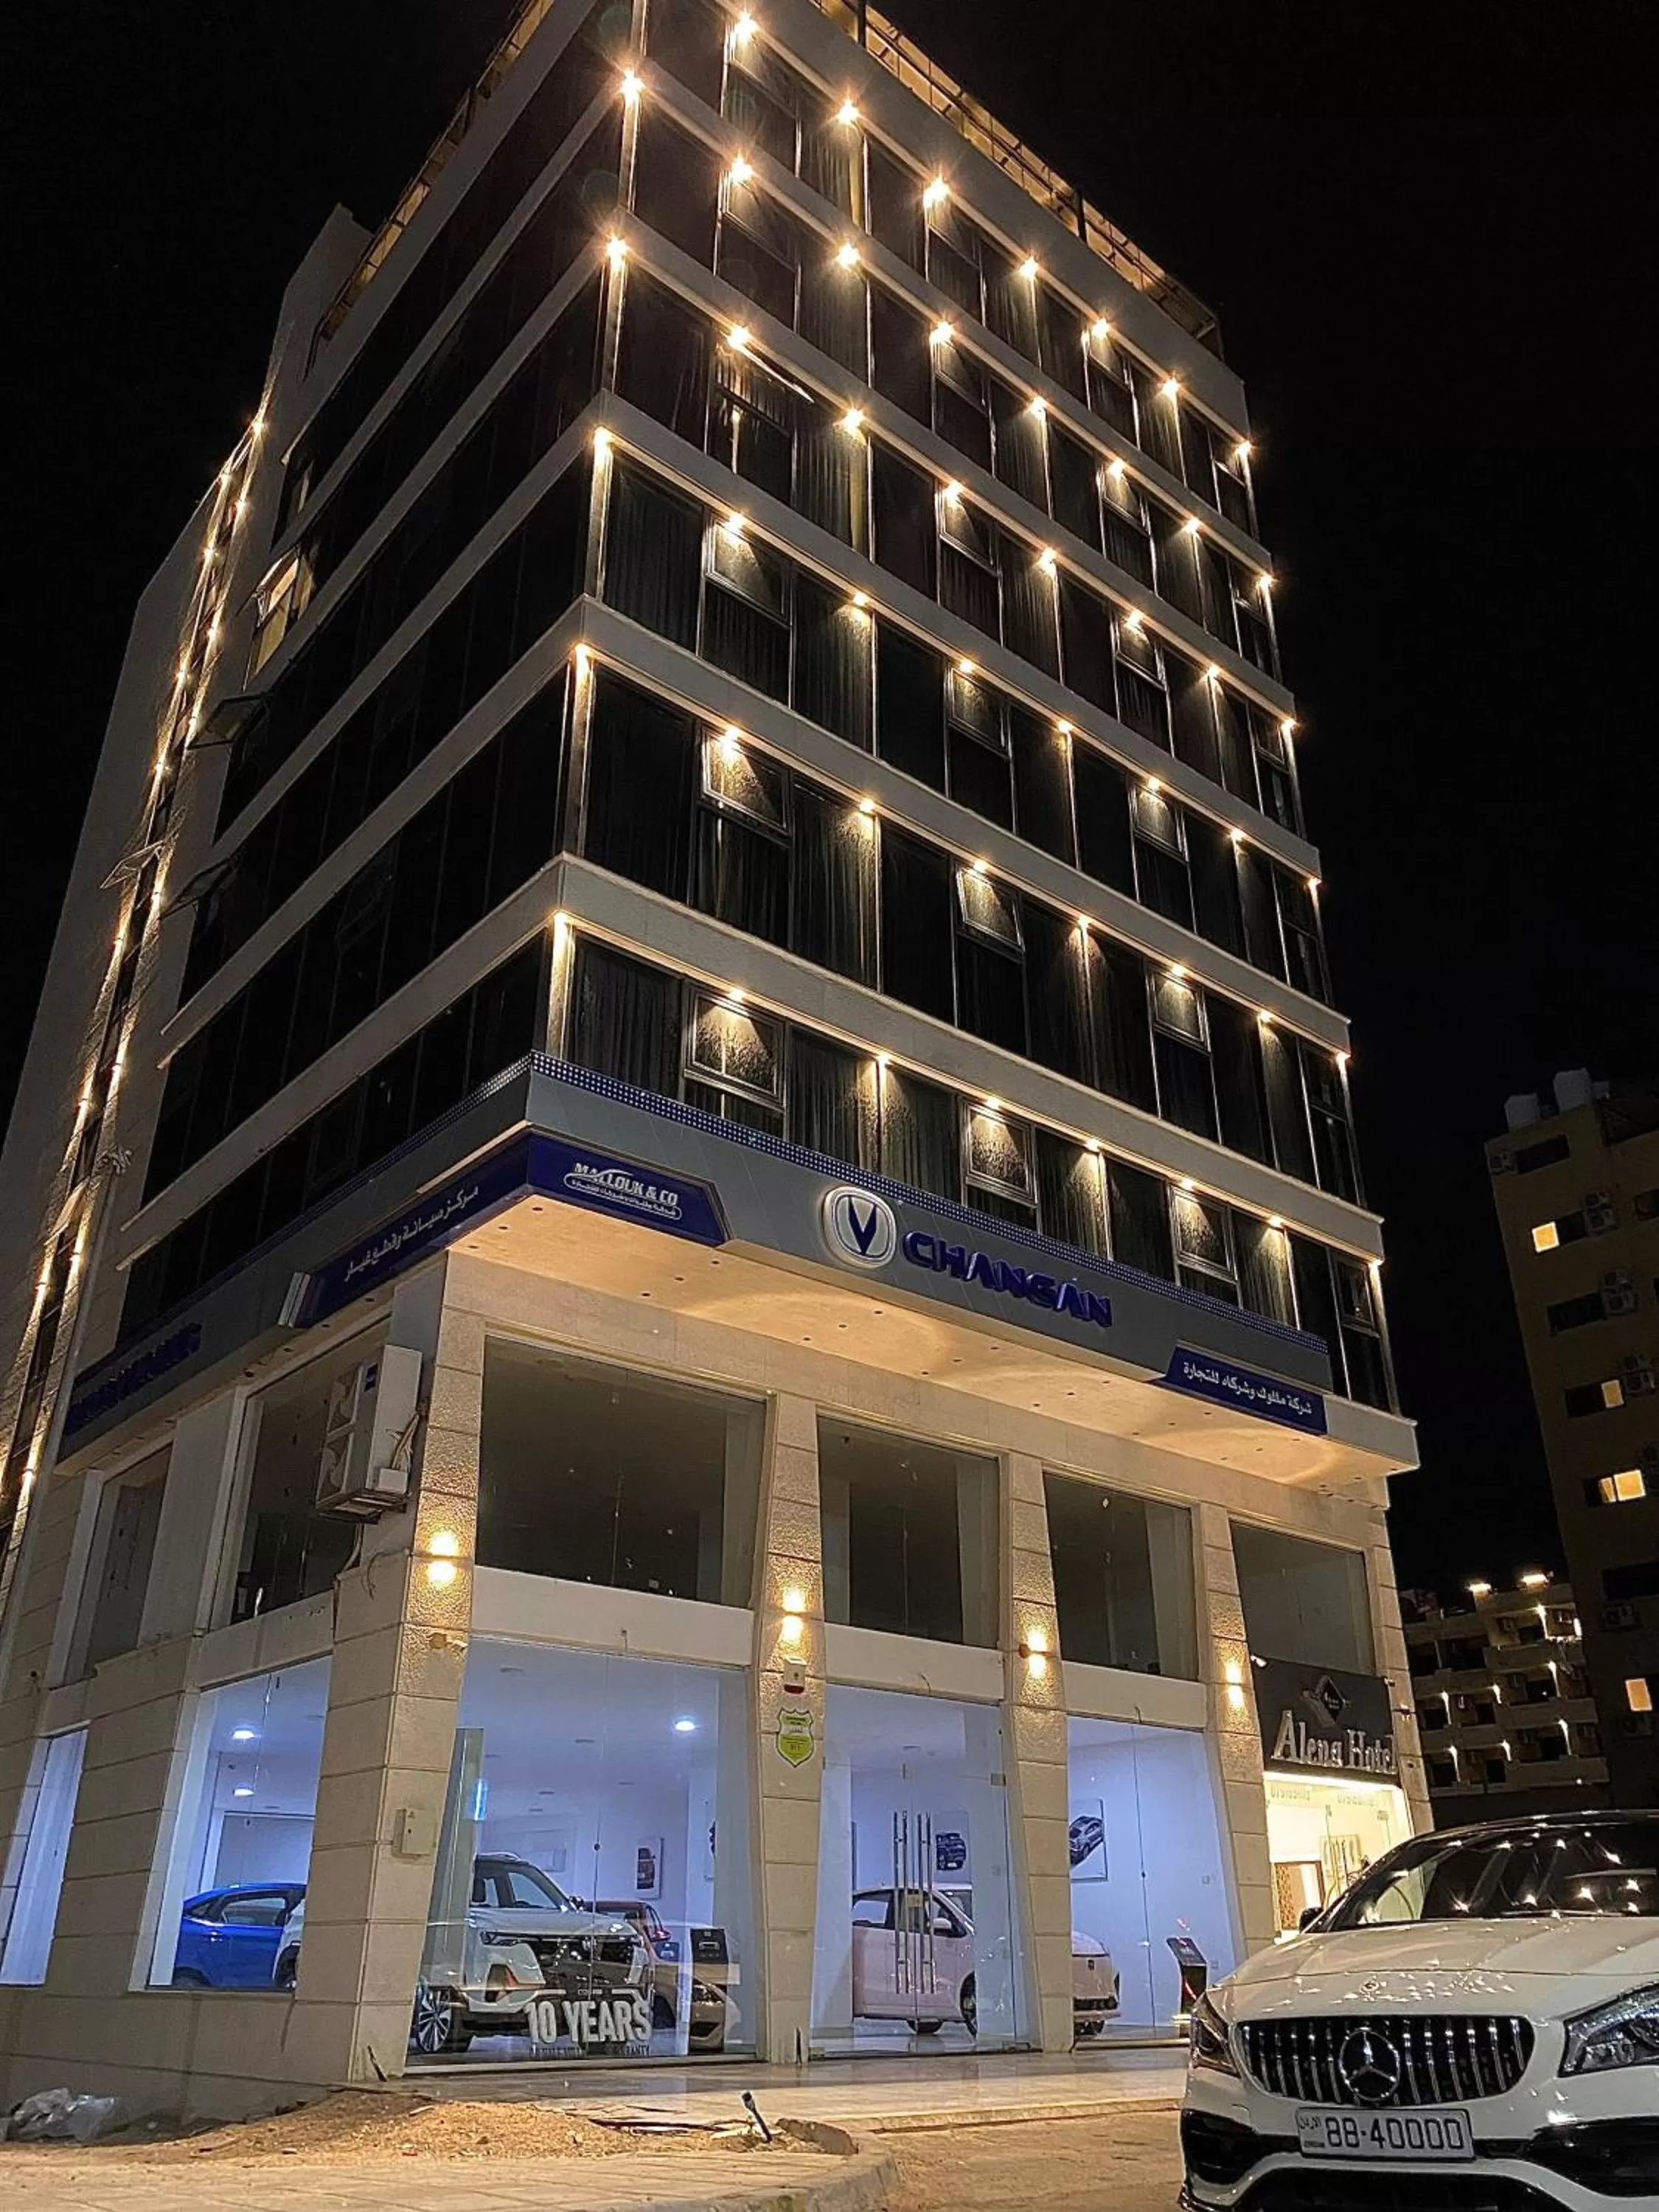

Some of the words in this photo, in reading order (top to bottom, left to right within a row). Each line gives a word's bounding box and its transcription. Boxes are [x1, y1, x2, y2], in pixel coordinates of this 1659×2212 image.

[574, 1162, 644, 1196] MALLOUK
[646, 1186, 658, 1200] &
[659, 1189, 678, 1206] CO
[902, 1231, 1113, 1328] CHANGAN
[1183, 1361, 1220, 1384] للتجارة
[1222, 1376, 1255, 1399] وشركاه
[1287, 1394, 1312, 1415] شركة
[1270, 1710, 1343, 1767] Alena
[524, 2000, 557, 2043] 10
[561, 2000, 653, 2042] YEARS
[1324, 2117, 1464, 2150] 88-40000
